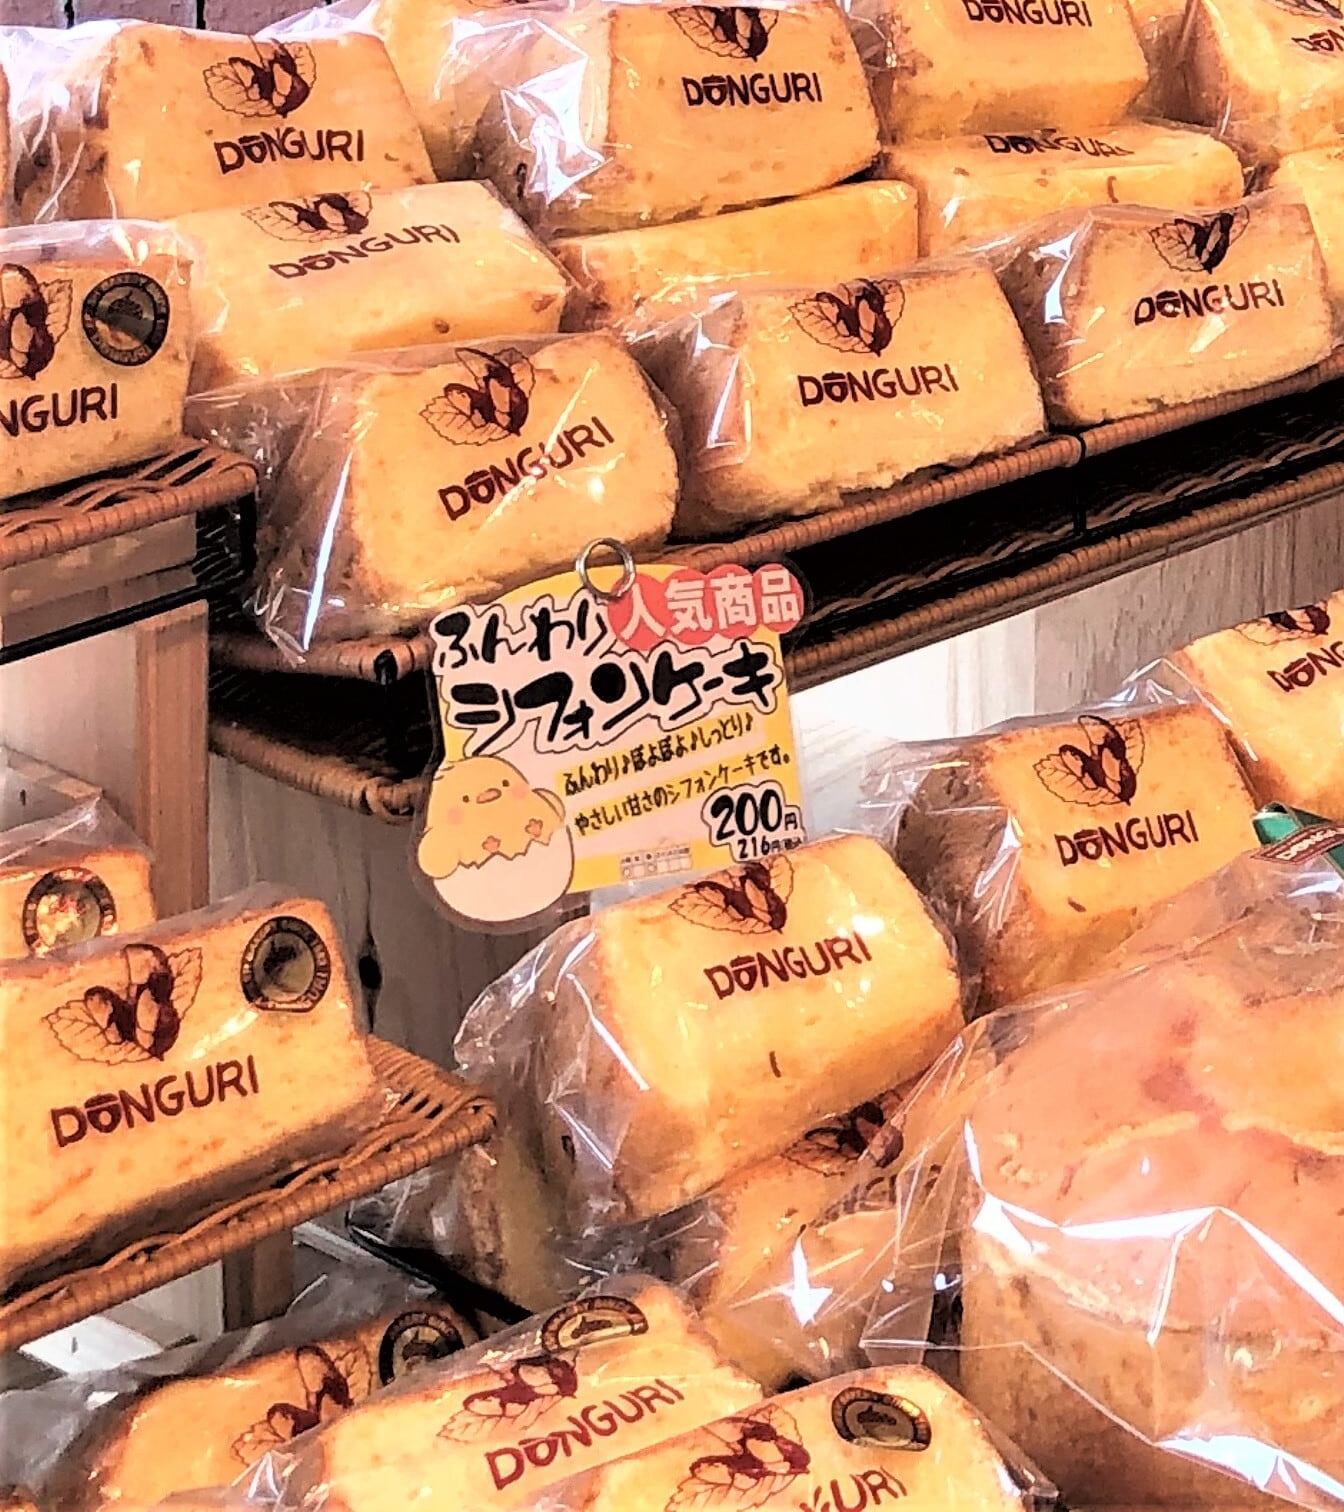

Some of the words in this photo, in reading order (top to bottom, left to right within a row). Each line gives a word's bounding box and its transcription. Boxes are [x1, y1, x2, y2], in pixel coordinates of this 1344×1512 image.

[681, 71, 824, 108] DONGURI
[213, 127, 365, 175] DONGURI
[269, 224, 460, 282] DONGURI
[1133, 278, 1285, 327] DONGURI
[796, 364, 961, 407] DONGURI
[435, 599, 608, 669] ふんわり
[620, 570, 800, 641] 人気商品
[451, 642, 774, 755] シフォンケーキ
[711, 789, 798, 840] 200円
[1053, 810, 1200, 867] DONGURI
[703, 931, 873, 1001] DONGURI
[50, 1055, 259, 1148] DONGURI
[484, 1378, 686, 1491] DONGURI
